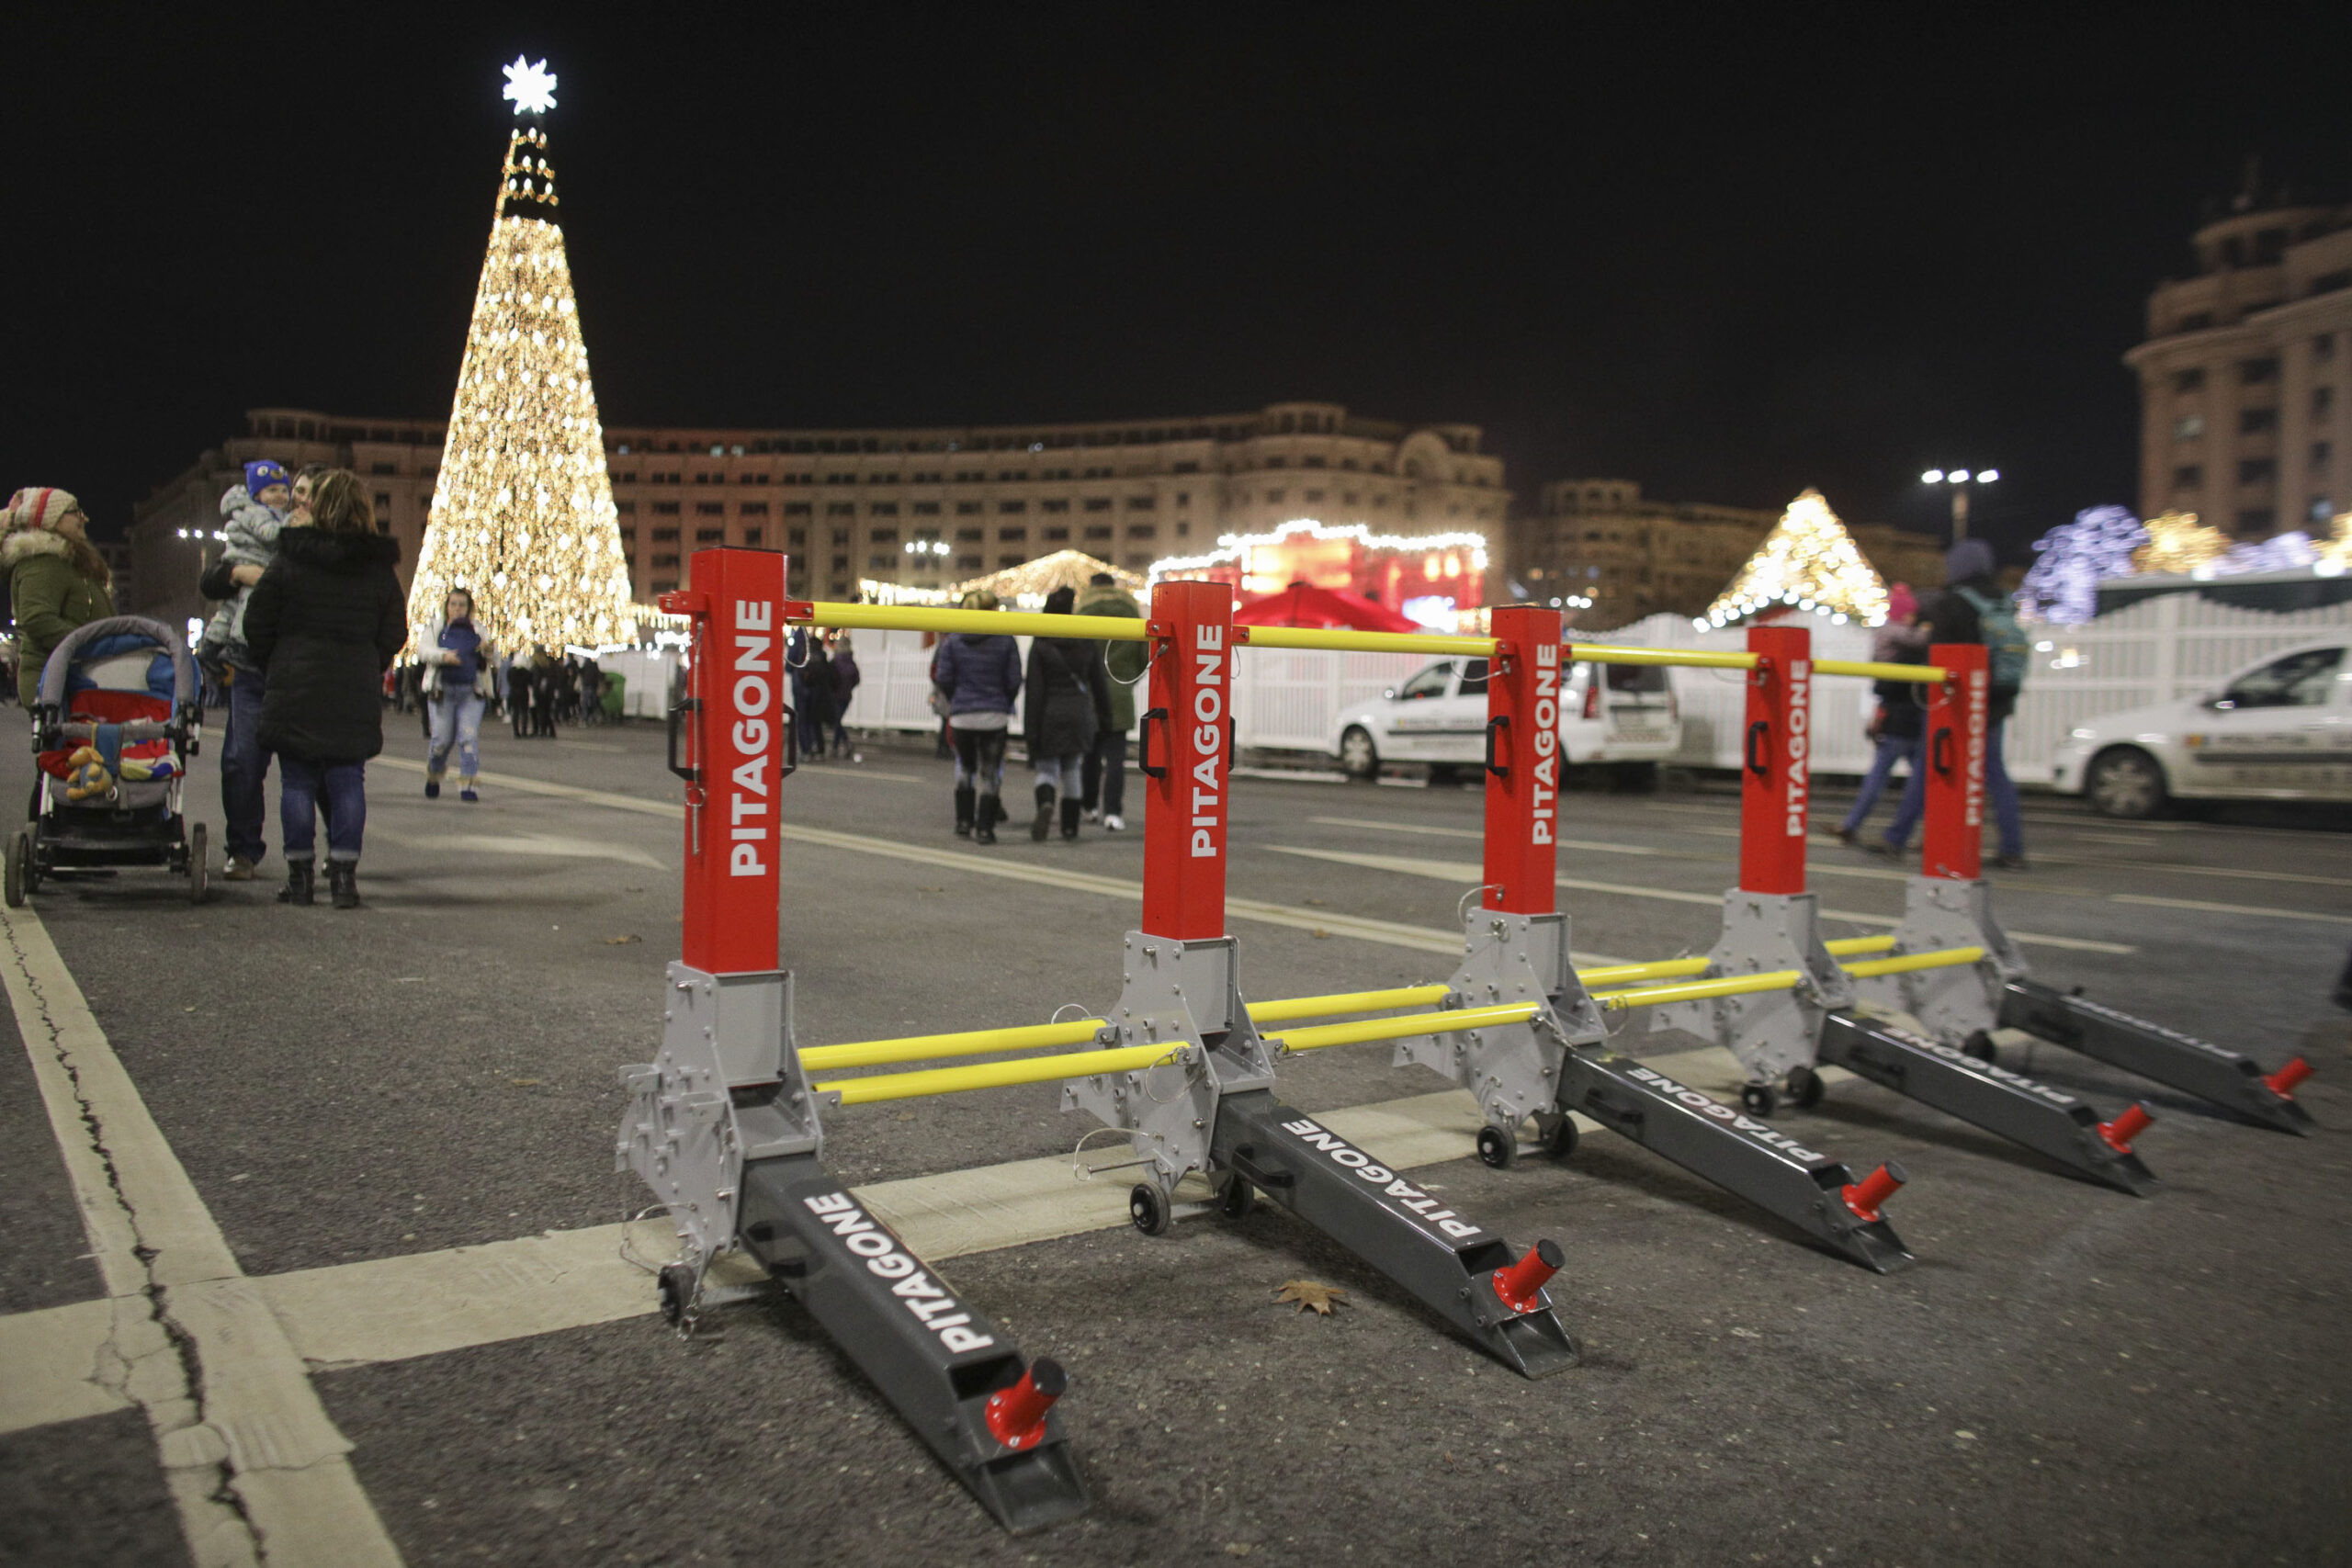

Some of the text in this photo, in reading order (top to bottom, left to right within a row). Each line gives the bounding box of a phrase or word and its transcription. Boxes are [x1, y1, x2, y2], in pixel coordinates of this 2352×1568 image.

[731, 600, 772, 877] PITAGONE
[1191, 624, 1223, 858] PITAGONE
[1532, 644, 1557, 845] PITAGONE
[1787, 660, 1808, 837] PITAGONE
[1281, 1119, 1482, 1238] PITAGONE
[1626, 1066, 1826, 1162] PITAGONE
[803, 1191, 995, 1354] PITAGONE
